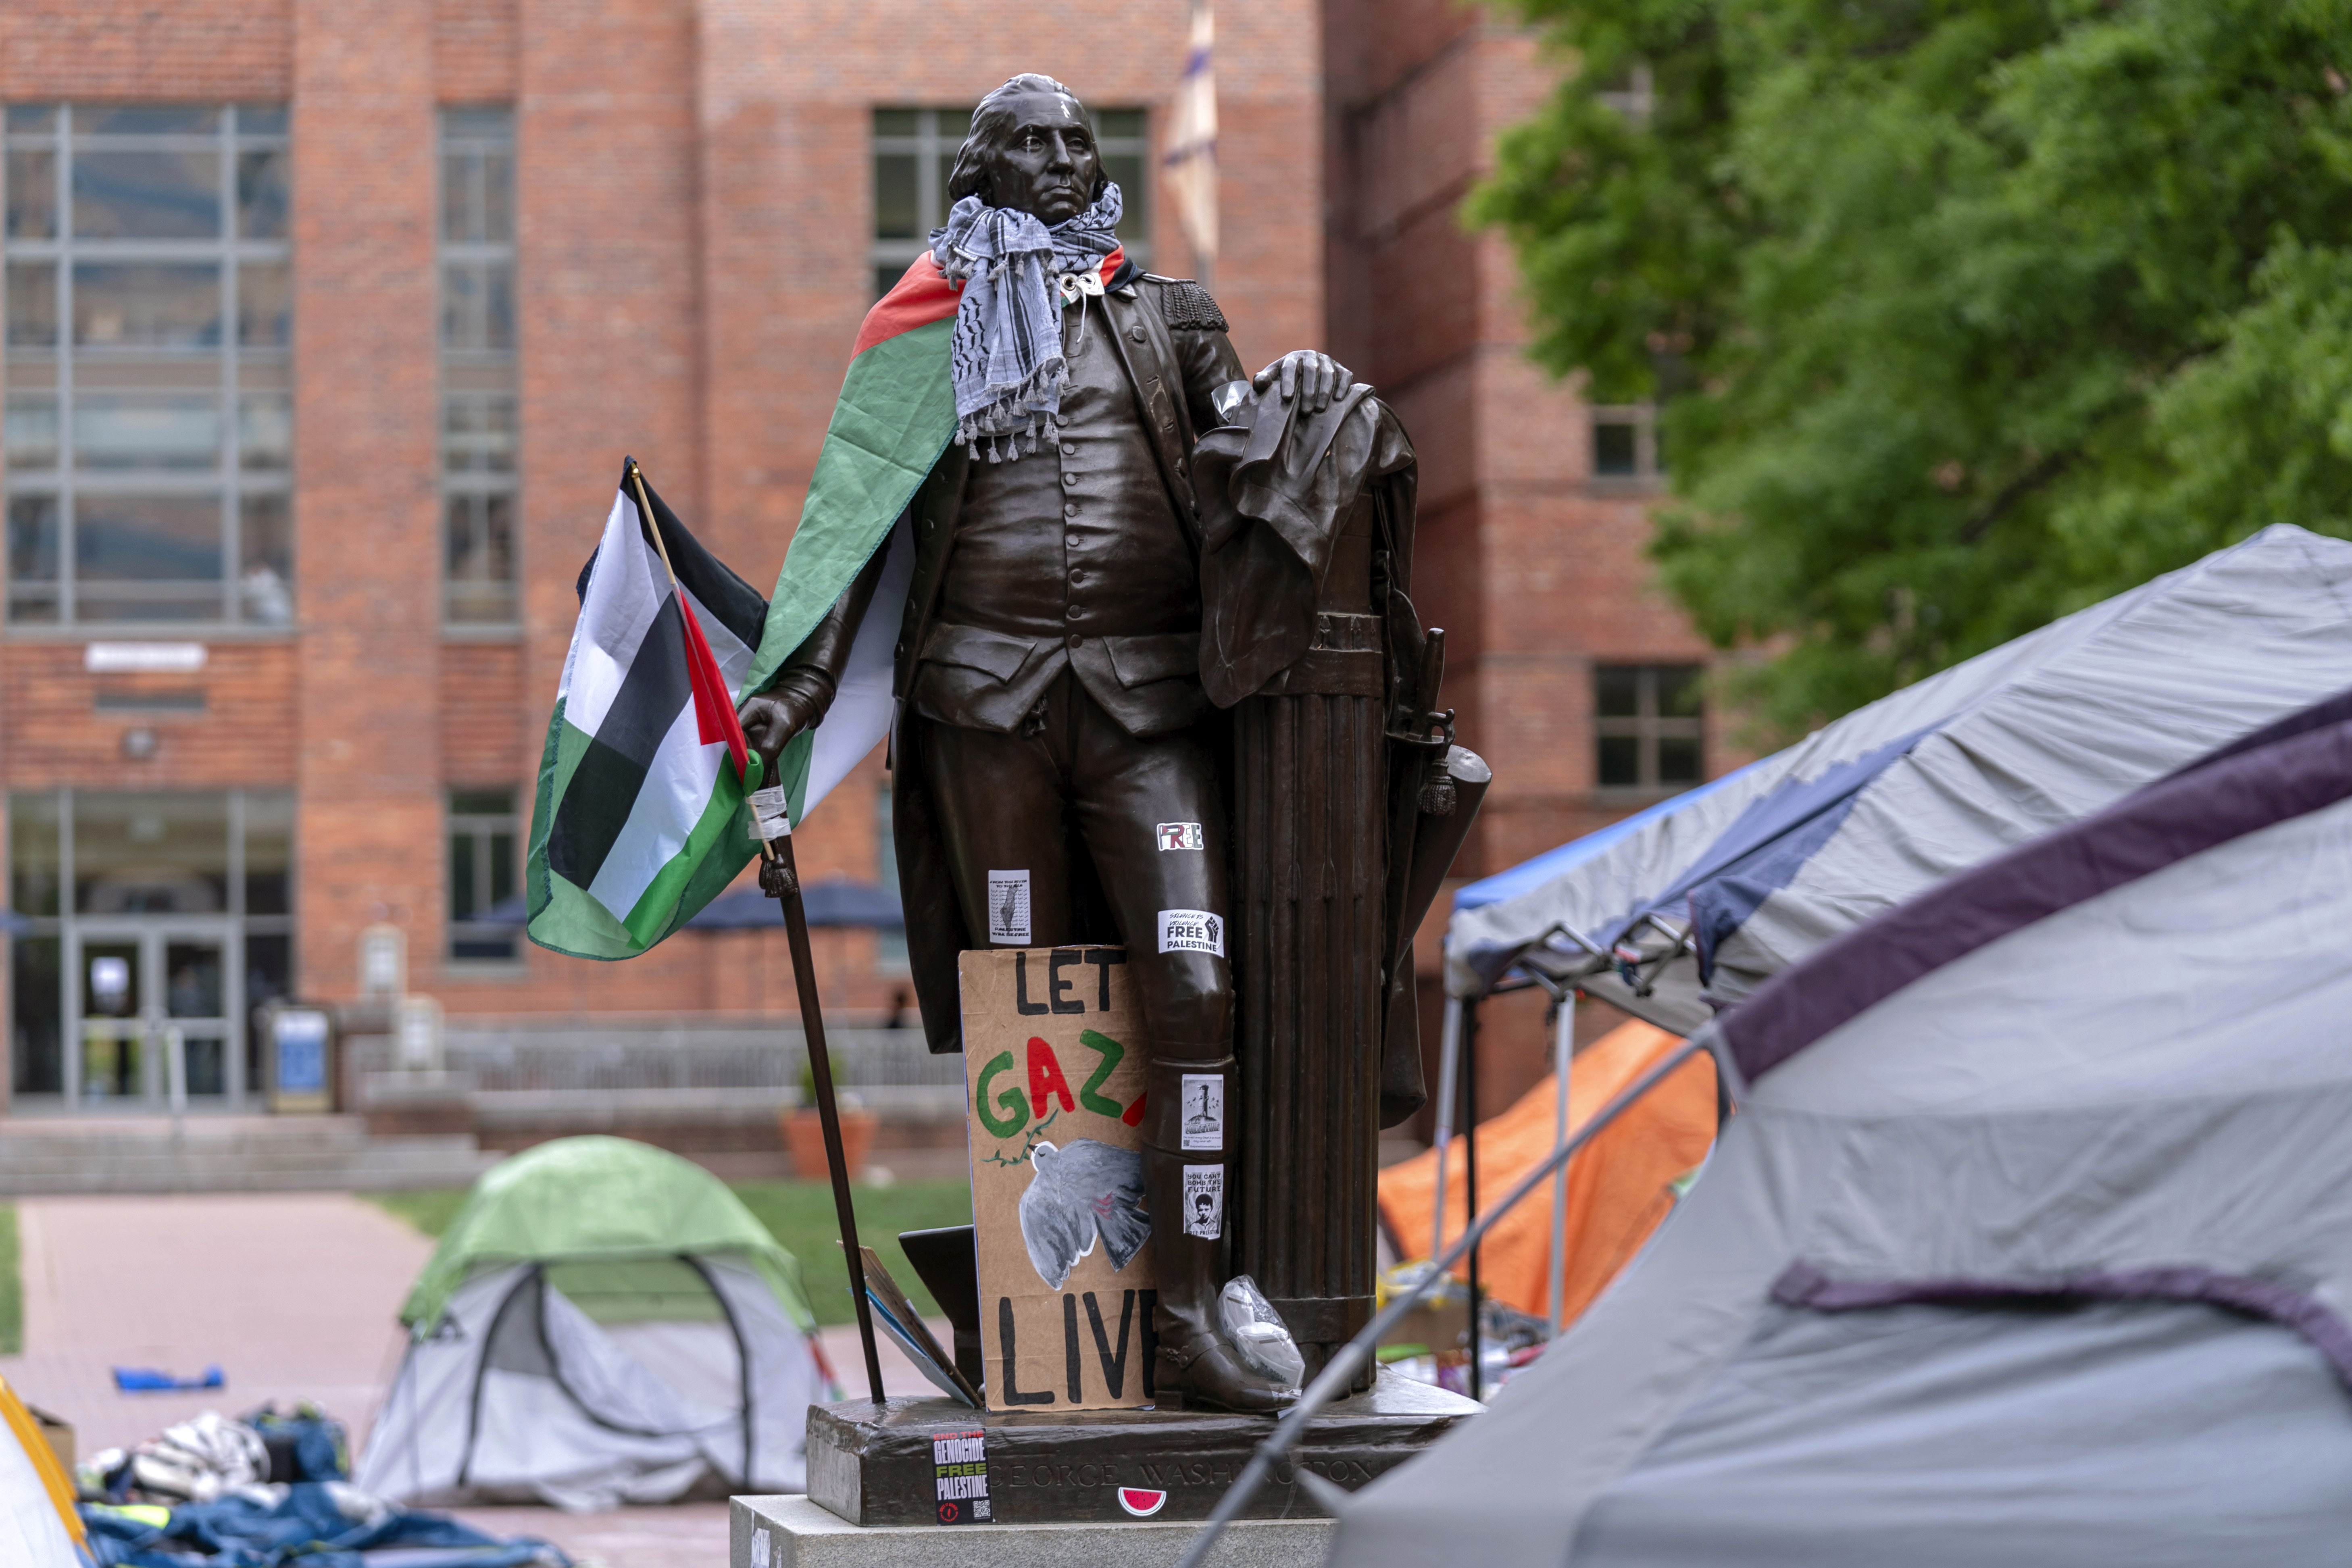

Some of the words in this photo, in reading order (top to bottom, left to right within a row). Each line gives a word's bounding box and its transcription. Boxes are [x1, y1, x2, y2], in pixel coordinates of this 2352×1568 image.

[1167, 926, 1202, 938] FREE
[1167, 940, 1217, 952] PALESTINE
[1016, 949, 1127, 1016] LET
[976, 1029, 1148, 1139] GAZ
[933, 1433, 958, 1441] END
[934, 1437, 986, 1464] GENOCIDE
[936, 1463, 987, 1478] FREE
[990, 1464, 1120, 1487] GEORGE
[1139, 1460, 1372, 1485] WASHGTON
[937, 1474, 988, 1500] PALESTINE
